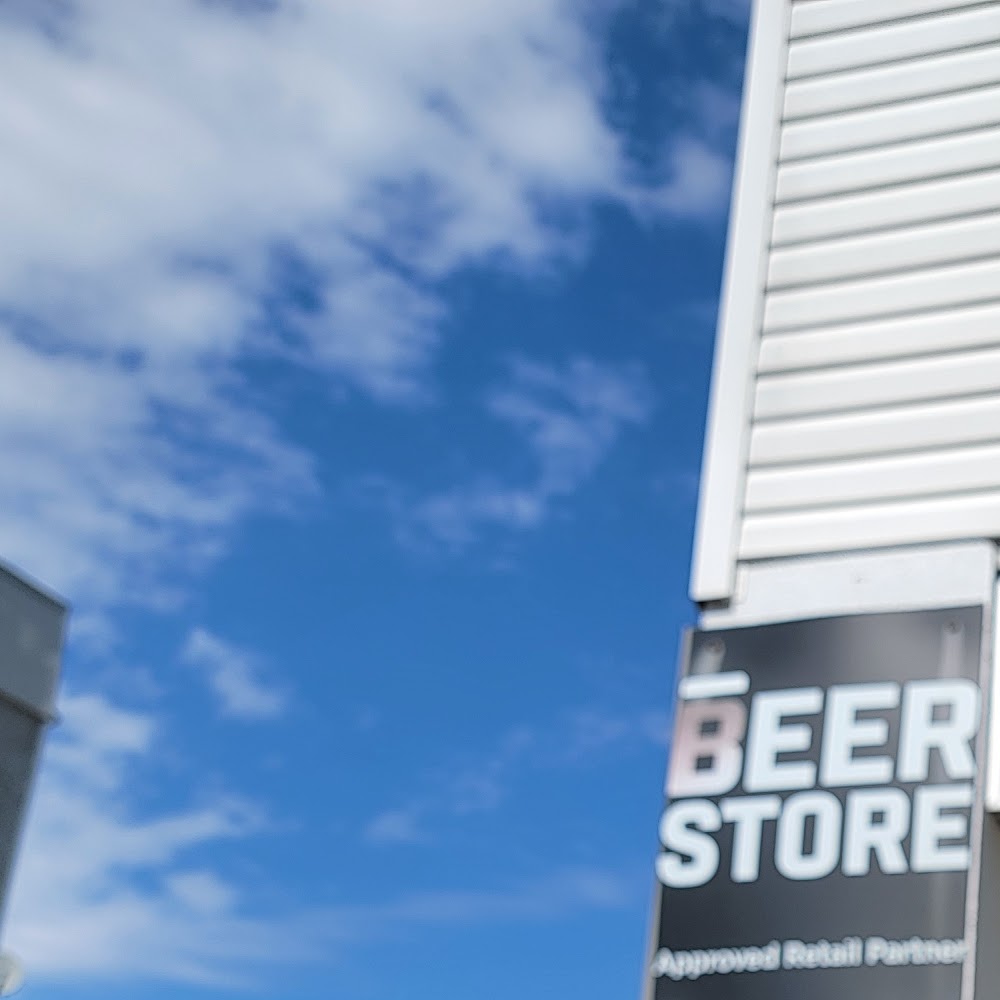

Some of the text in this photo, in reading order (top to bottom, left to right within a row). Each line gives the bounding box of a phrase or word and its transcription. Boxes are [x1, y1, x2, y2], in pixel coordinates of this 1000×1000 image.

[664, 678, 982, 798] BEER
[655, 783, 973, 887] STORE
[651, 936, 966, 980] Approved Retail Partner
